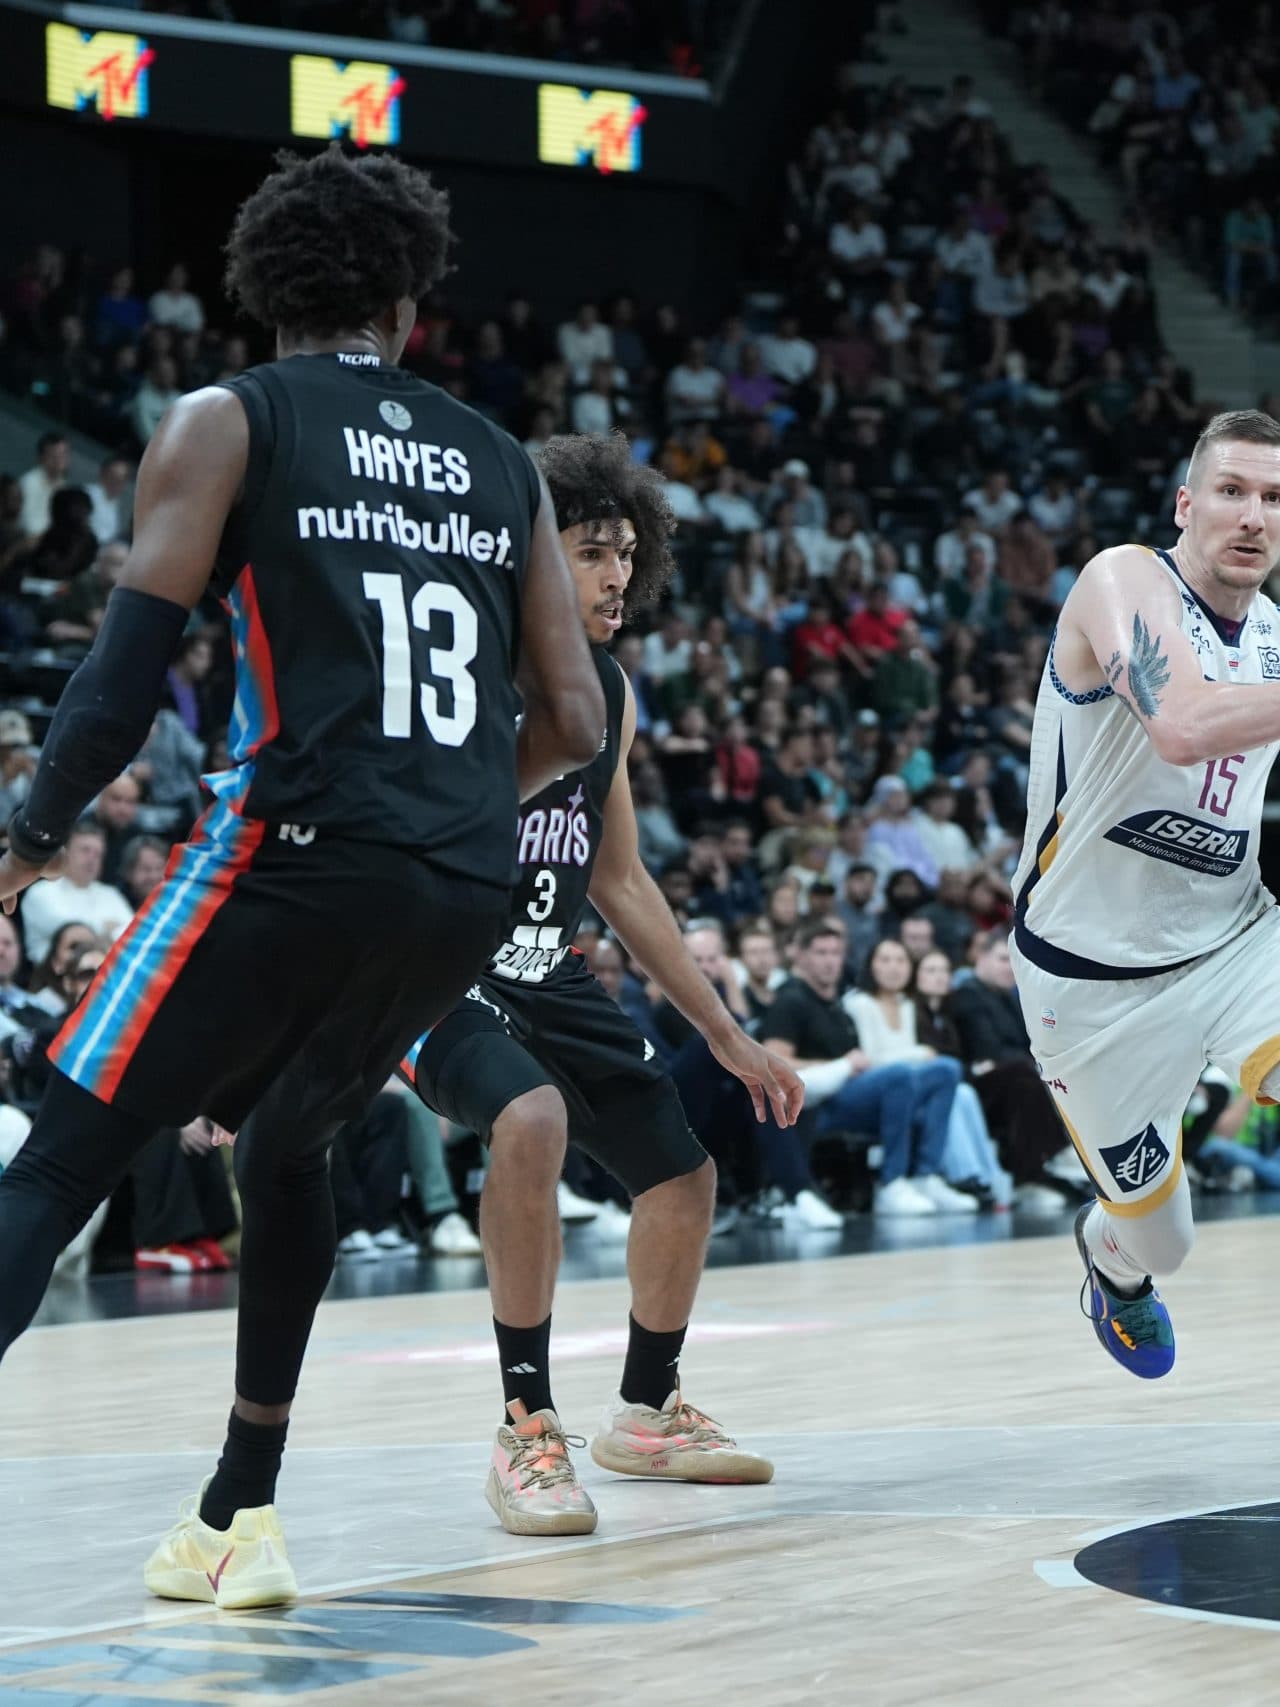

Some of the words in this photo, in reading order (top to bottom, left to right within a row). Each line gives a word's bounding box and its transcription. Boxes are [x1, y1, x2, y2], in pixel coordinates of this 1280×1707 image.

[46, 22, 157, 120] MTV
[290, 54, 406, 149] MTV
[538, 83, 648, 174] MTV
[343, 427, 471, 495] HAYES
[362, 571, 478, 747] 13
[1198, 754, 1245, 817] 15
[516, 807, 590, 867] ARIS
[1128, 836, 1190, 864] Maintenance
[1145, 814, 1241, 858] ISERBA
[526, 869, 557, 922] 3
